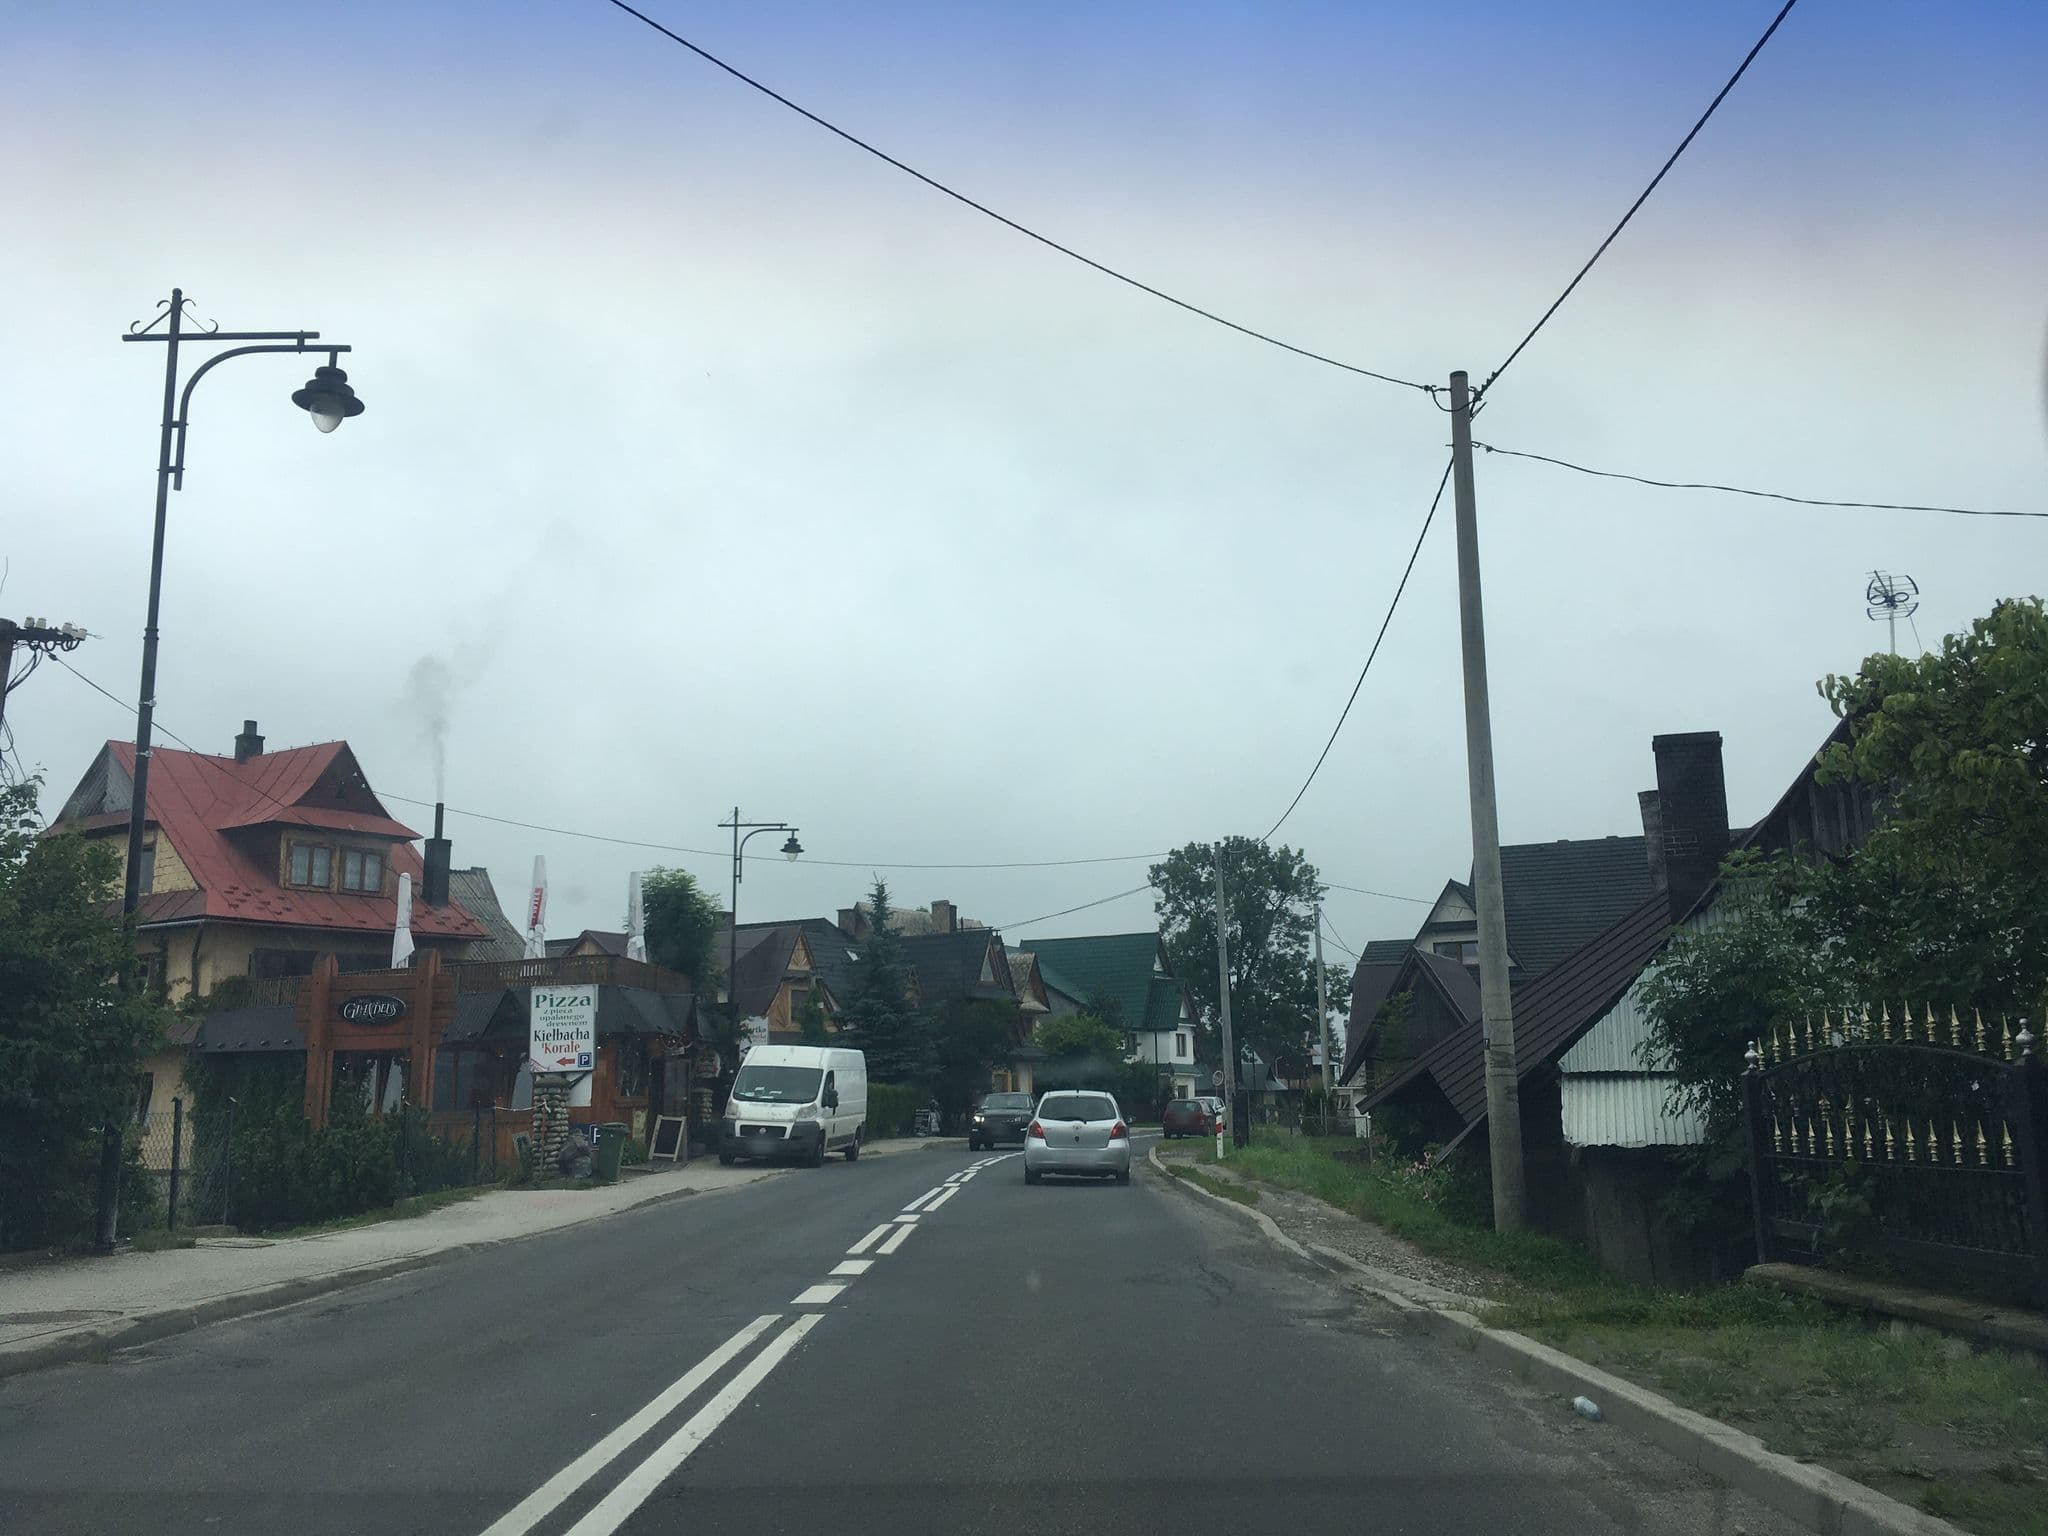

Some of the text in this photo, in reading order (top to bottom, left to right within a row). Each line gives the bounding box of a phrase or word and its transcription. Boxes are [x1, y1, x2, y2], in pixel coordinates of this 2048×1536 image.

[535, 993, 591, 1008] Pizza
[539, 1014, 585, 1022] opalanego
[544, 1041, 580, 1054] Korale
[581, 1055, 589, 1065] P
